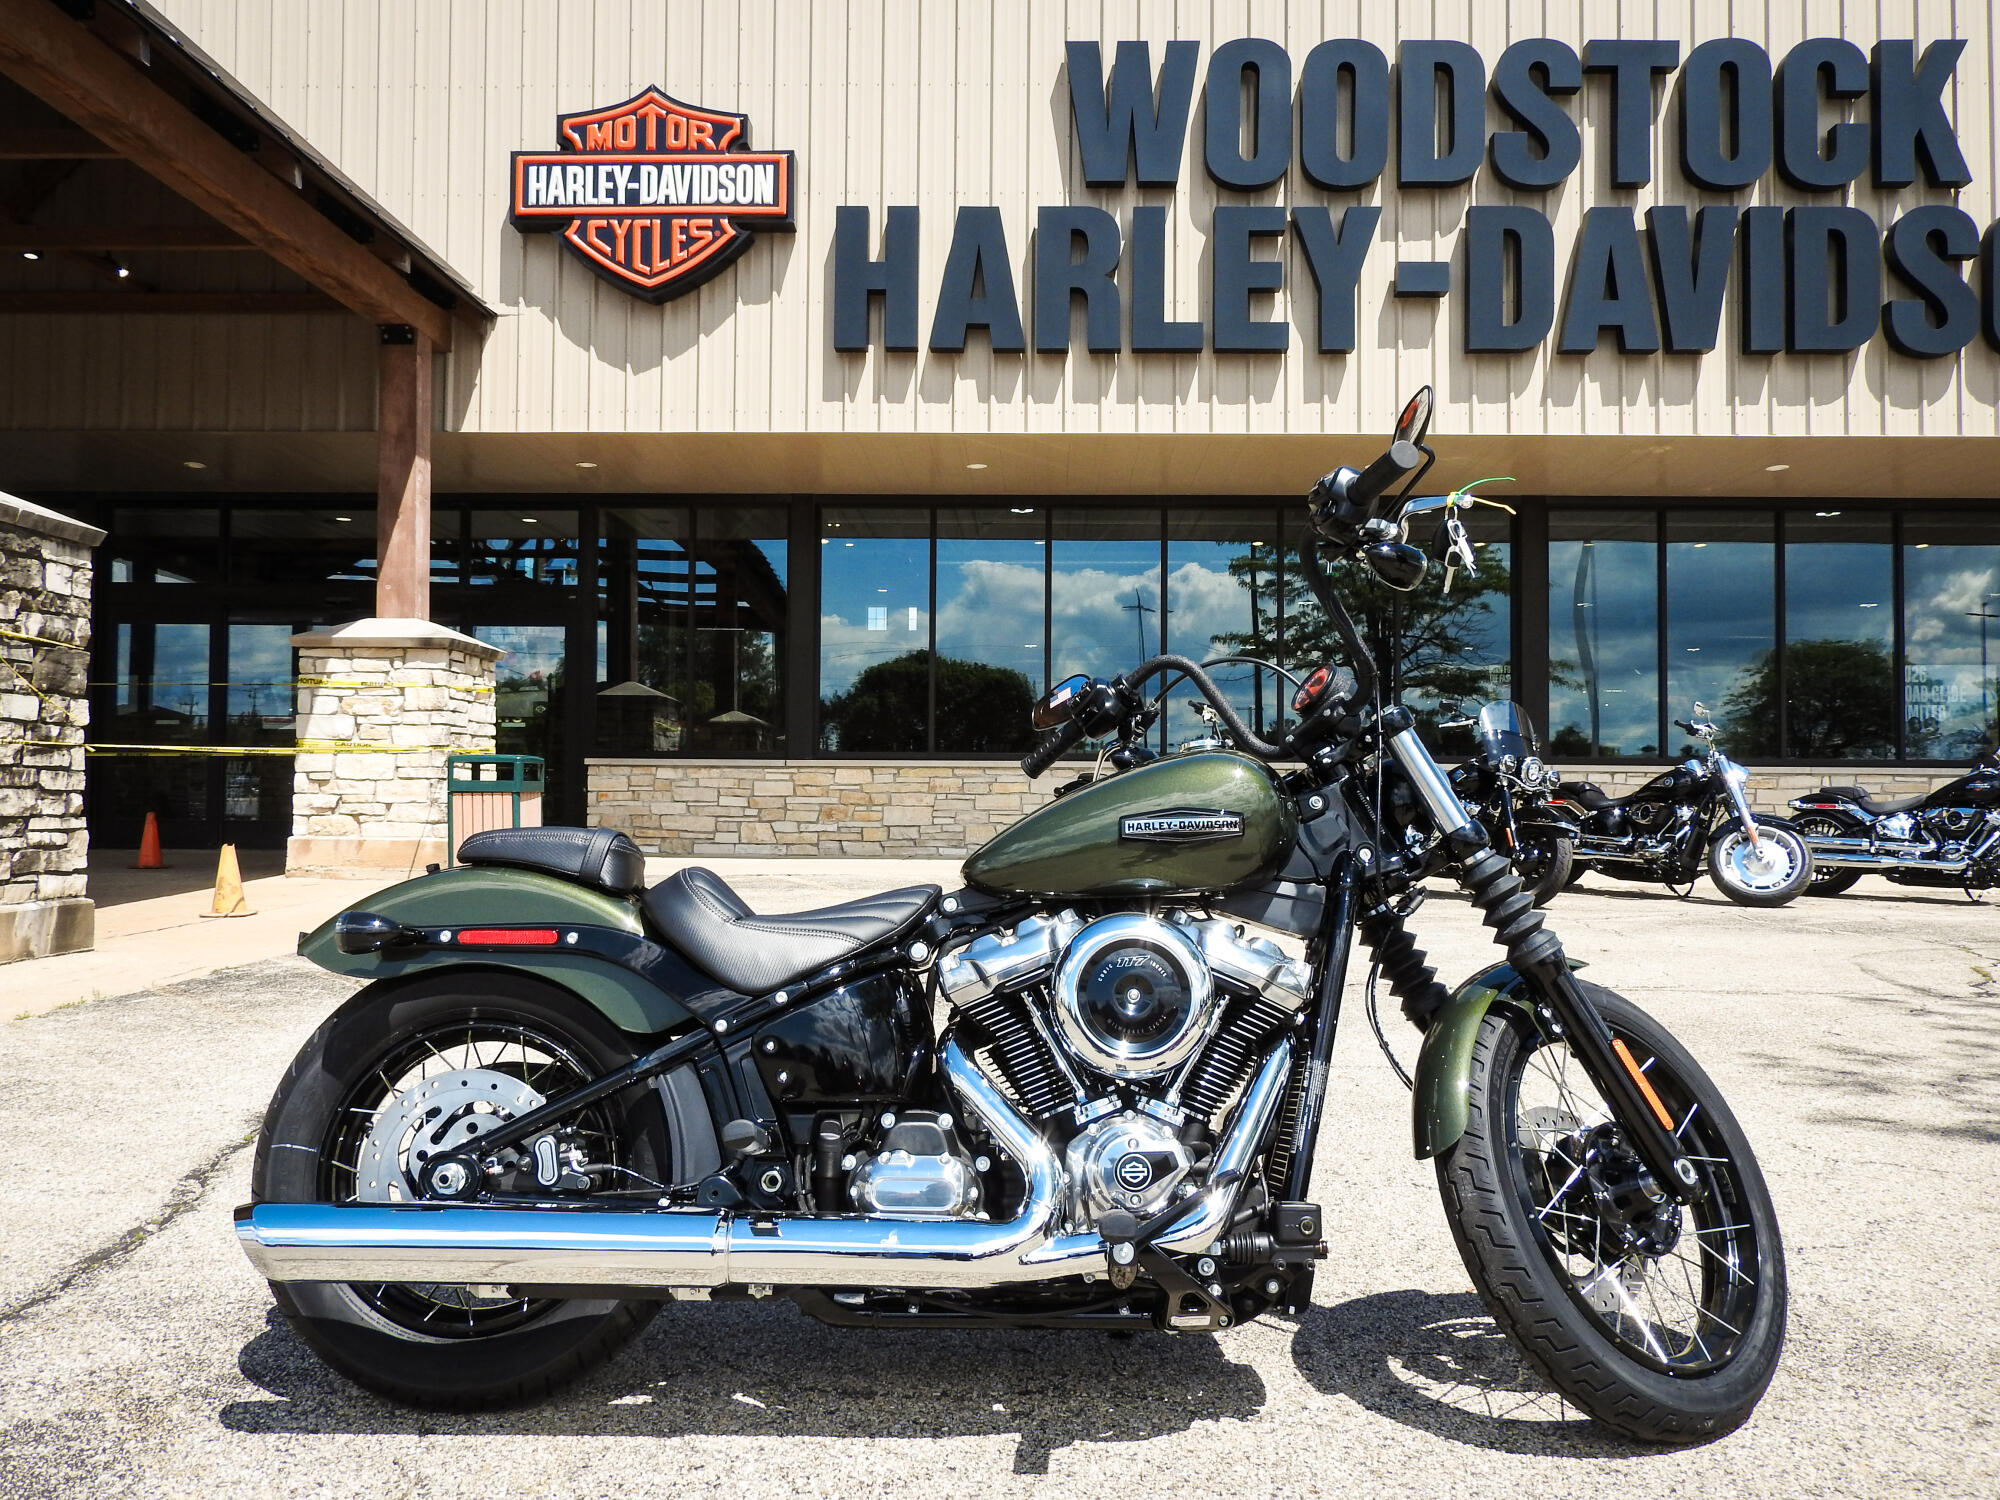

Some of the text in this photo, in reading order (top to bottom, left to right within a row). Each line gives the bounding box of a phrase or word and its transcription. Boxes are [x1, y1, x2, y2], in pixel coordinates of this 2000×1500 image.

[587, 102, 715, 151] MOTOR
[1065, 38, 1973, 192] WOODSTOCK
[528, 163, 775, 205] HARLEY-DAVIDSON
[587, 218, 715, 274] CYCLES
[834, 205, 2000, 359] HARLEY-DAVIDS
[1127, 820, 1238, 832] HARLEY-DAVIDSON
[1116, 955, 1151, 968] 117
